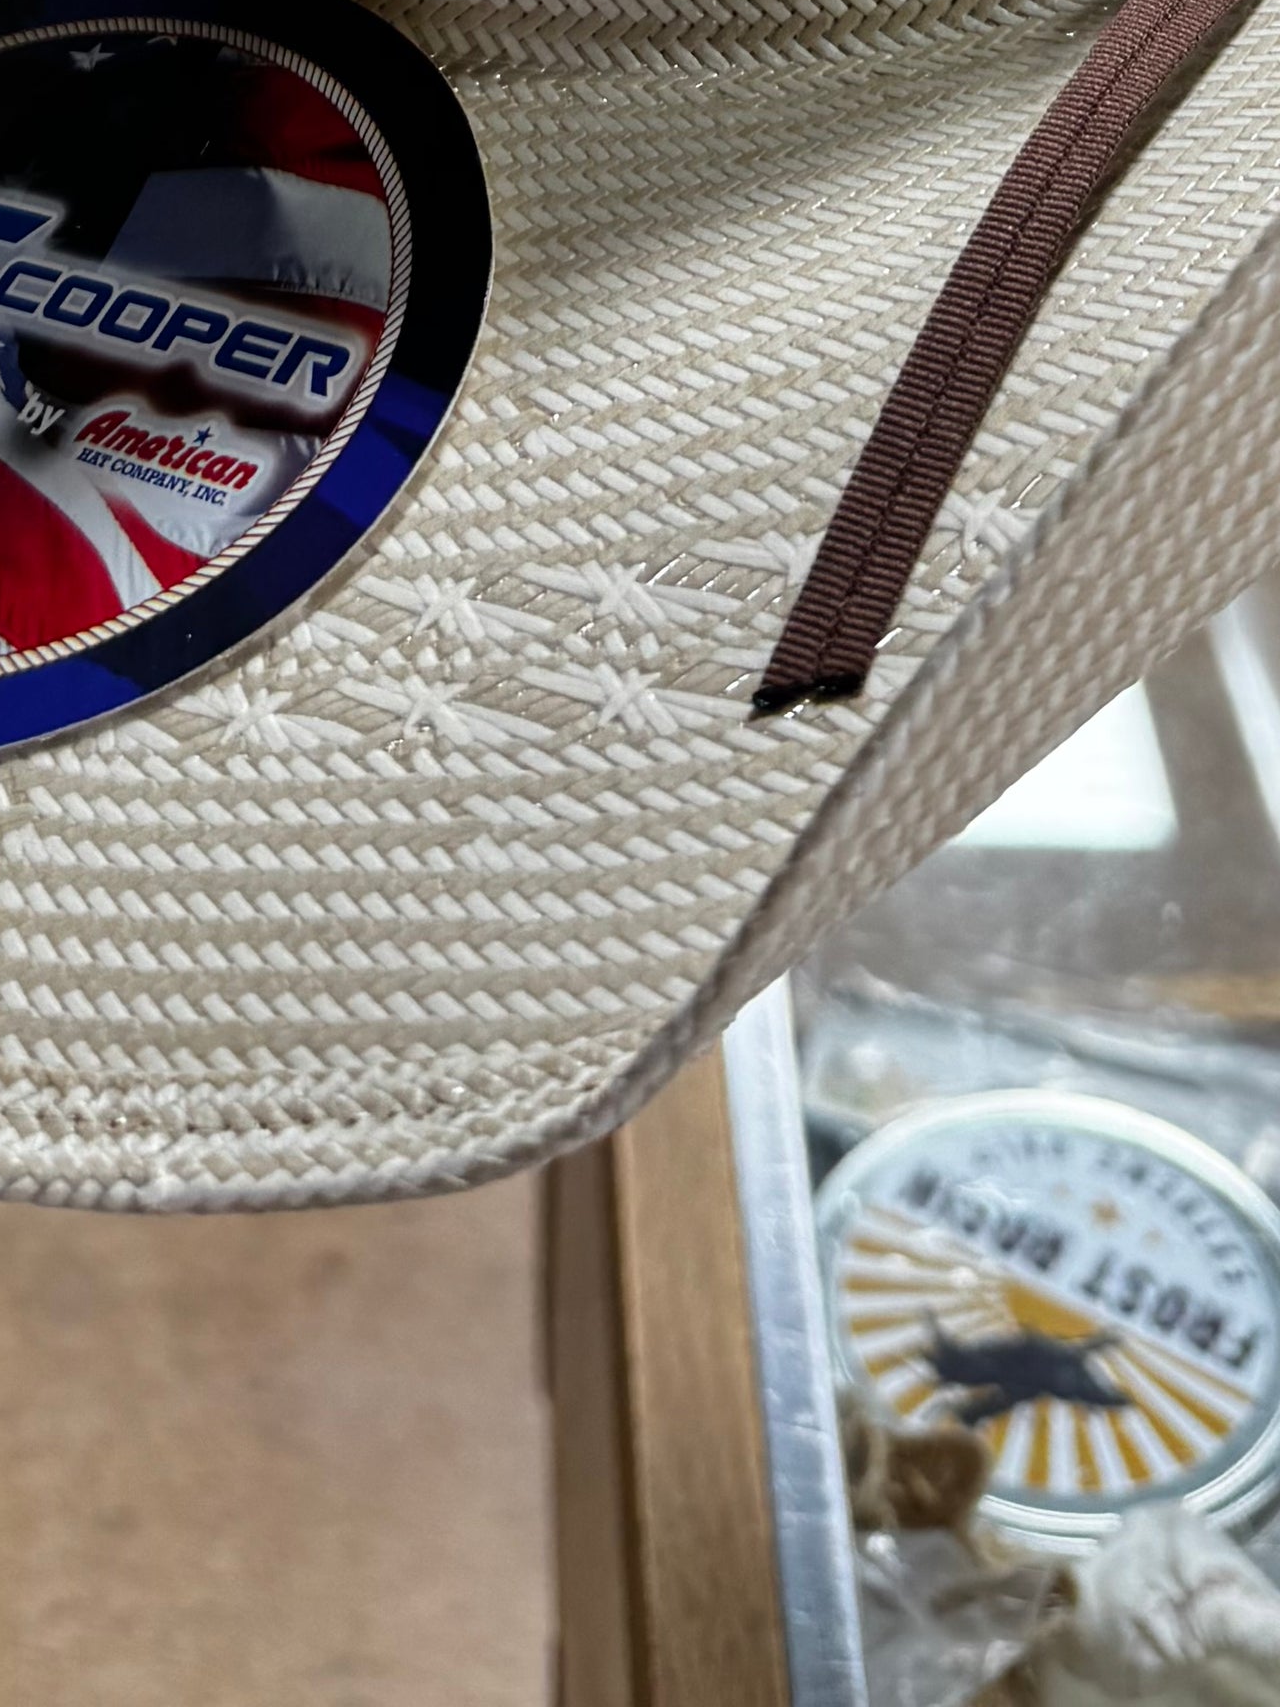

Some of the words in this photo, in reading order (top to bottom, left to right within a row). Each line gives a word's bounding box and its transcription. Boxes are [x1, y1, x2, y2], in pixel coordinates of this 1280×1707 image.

[17, 390, 66, 436] by
[73, 409, 260, 491] American
[76, 446, 113, 470] HAT
[110, 456, 193, 498] COMPANY,
[192, 485, 228, 507] INC.
